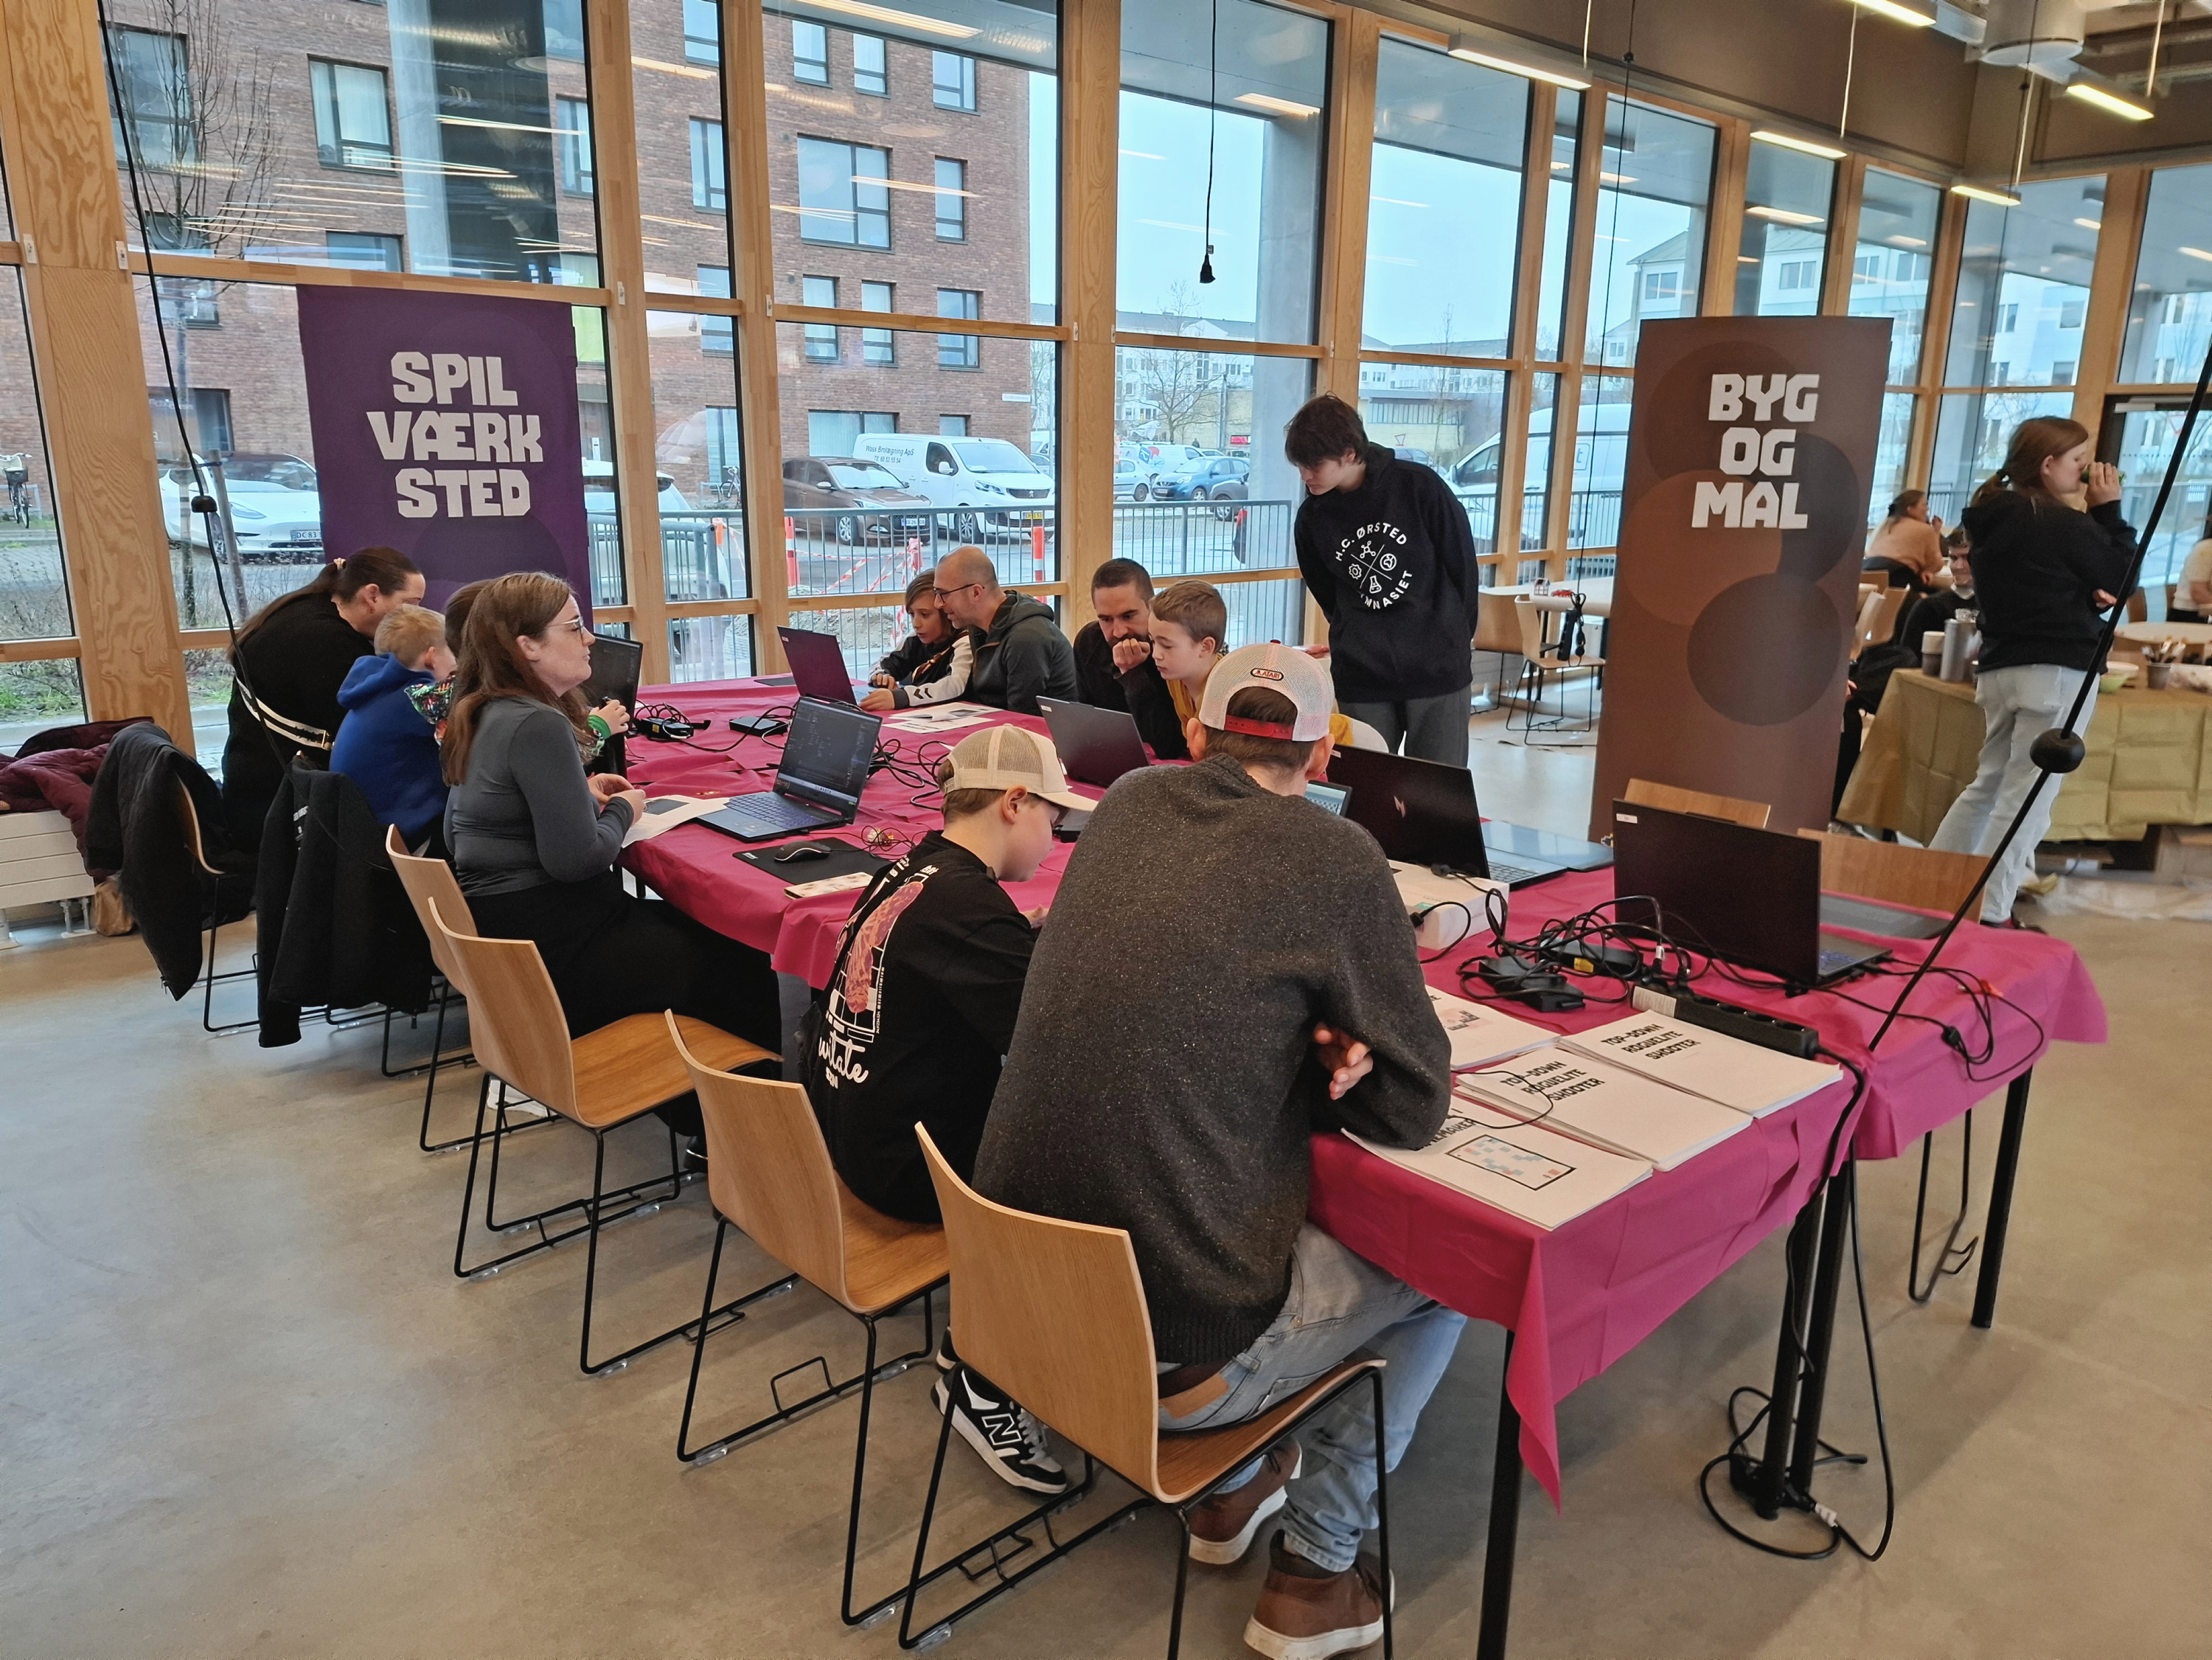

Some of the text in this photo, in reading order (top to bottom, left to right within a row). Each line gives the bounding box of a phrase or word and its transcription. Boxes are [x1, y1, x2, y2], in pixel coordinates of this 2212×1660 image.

[391, 351, 518, 406] SPIL
[1708, 373, 1820, 422] BYG
[366, 411, 543, 463] VÆRK
[904, 448, 914, 457] ApS
[1719, 427, 1796, 476] OG
[394, 468, 531, 518] STED
[1691, 481, 1808, 529] MAL
[1335, 522, 1407, 561] H.C. ØRSTED
[1360, 570, 1413, 609] MNASIET
[1262, 670, 1280, 679] ATARI
[1600, 1023, 1664, 1046] TOP-DOWN
[1621, 1030, 1684, 1054] ROGUELITE
[1645, 1038, 1701, 1060] SHOOTER
[1520, 1069, 1587, 1094] ROGUELITE
[1546, 1077, 1606, 1101] SHOOTER
